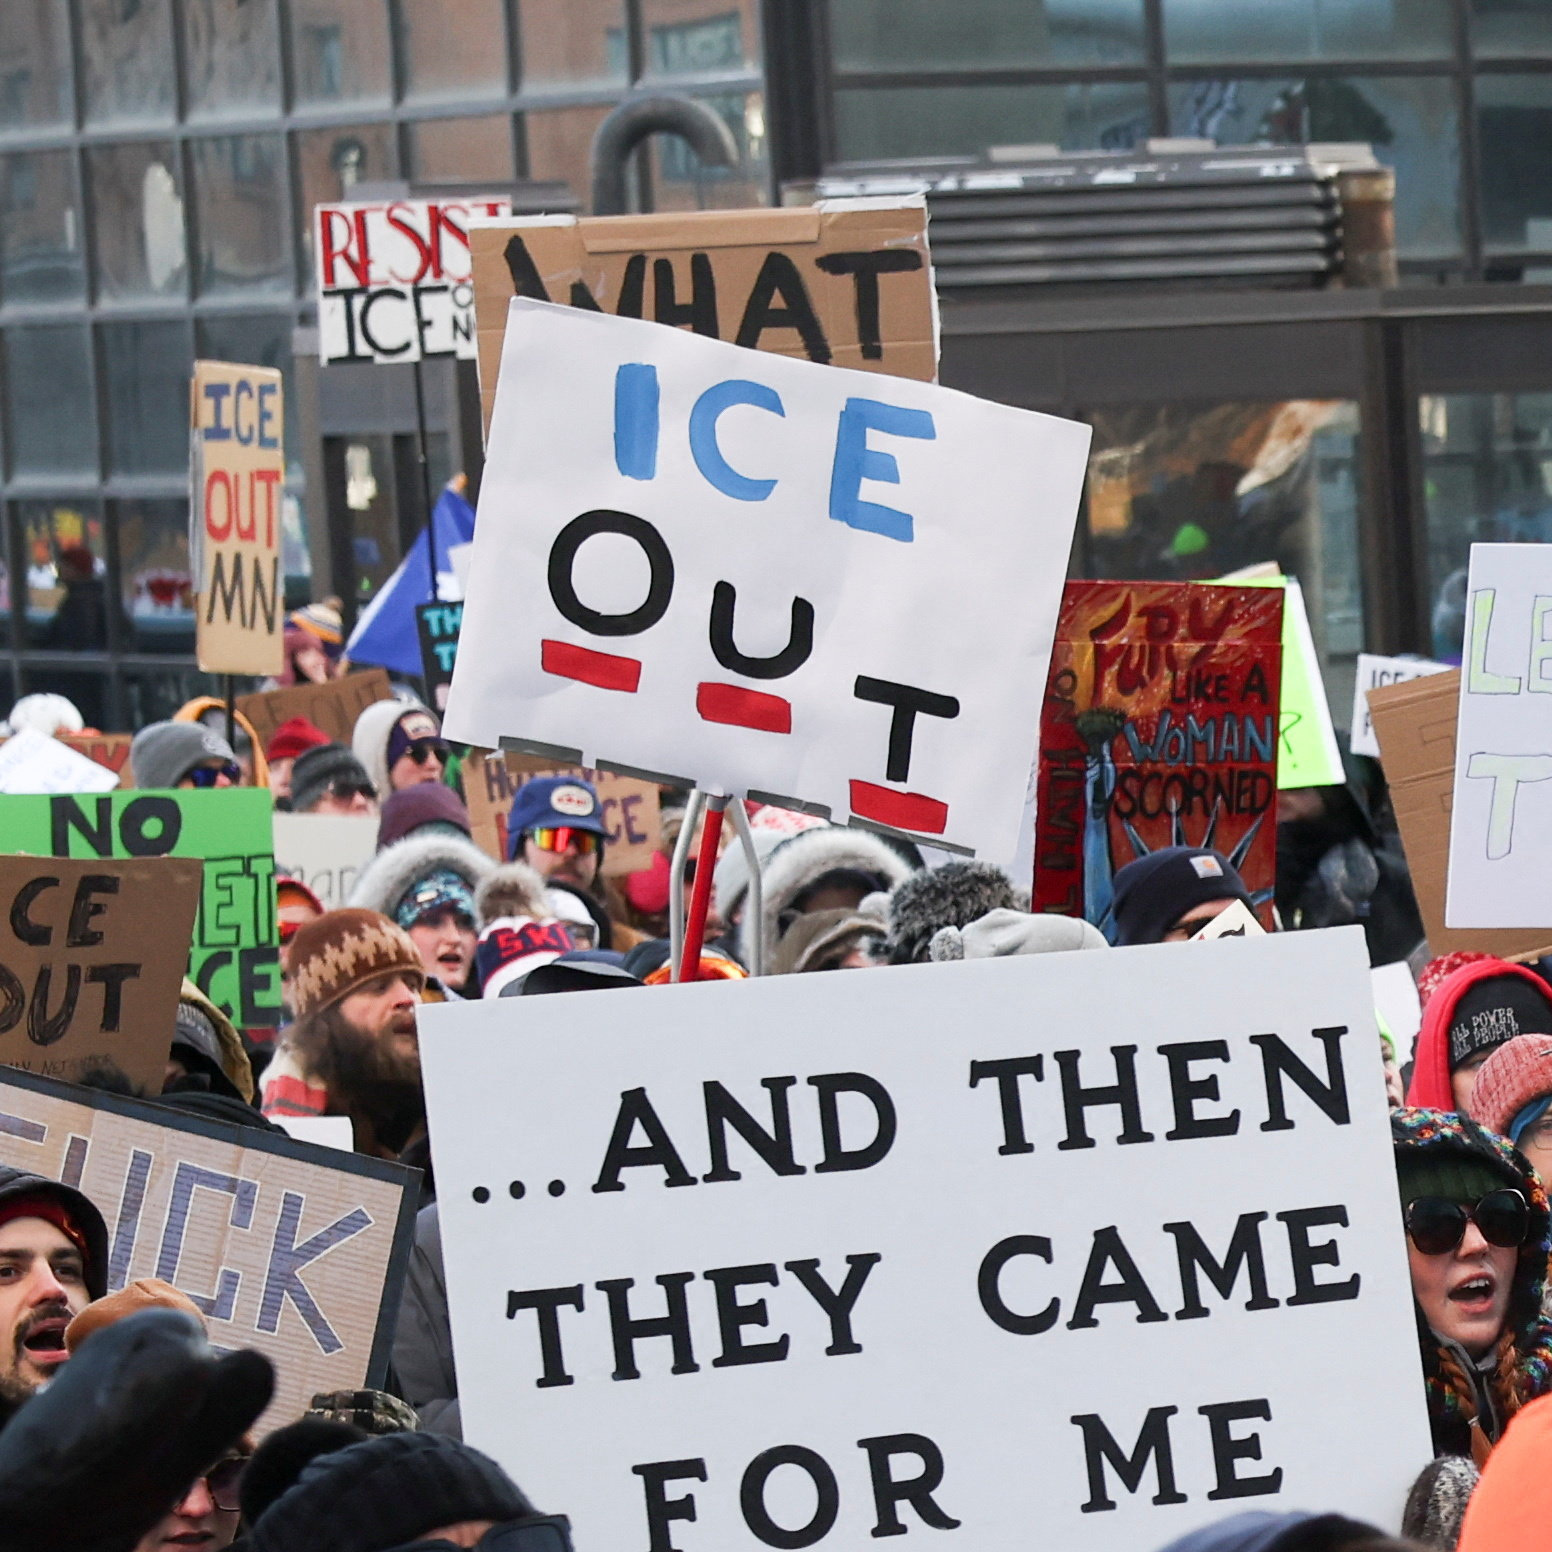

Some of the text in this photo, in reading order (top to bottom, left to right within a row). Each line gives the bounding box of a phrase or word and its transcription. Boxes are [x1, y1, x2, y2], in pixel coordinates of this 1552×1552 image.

[320, 202, 499, 288] RESIS
[323, 284, 457, 364] ICE
[503, 234, 923, 364] WHAT
[202, 381, 279, 451] ICE
[614, 362, 937, 543] ICE
[205, 469, 281, 550] OUT
[207, 551, 279, 636] MN
[547, 509, 961, 784] OUT
[1170, 661, 1270, 705] LIKE A
[1123, 708, 1274, 766] WOMAN
[50, 796, 182, 857] NO
[1113, 766, 1274, 820] SCORNED
[496, 922, 572, 960] SKI
[1471, 1007, 1516, 1027] POWER
[1472, 1021, 1521, 1048] PEOPLE
[968, 1025, 1351, 1156] THEN
[506, 1204, 1362, 1390] THEY CAME
[1070, 1398, 1285, 1514] ME
